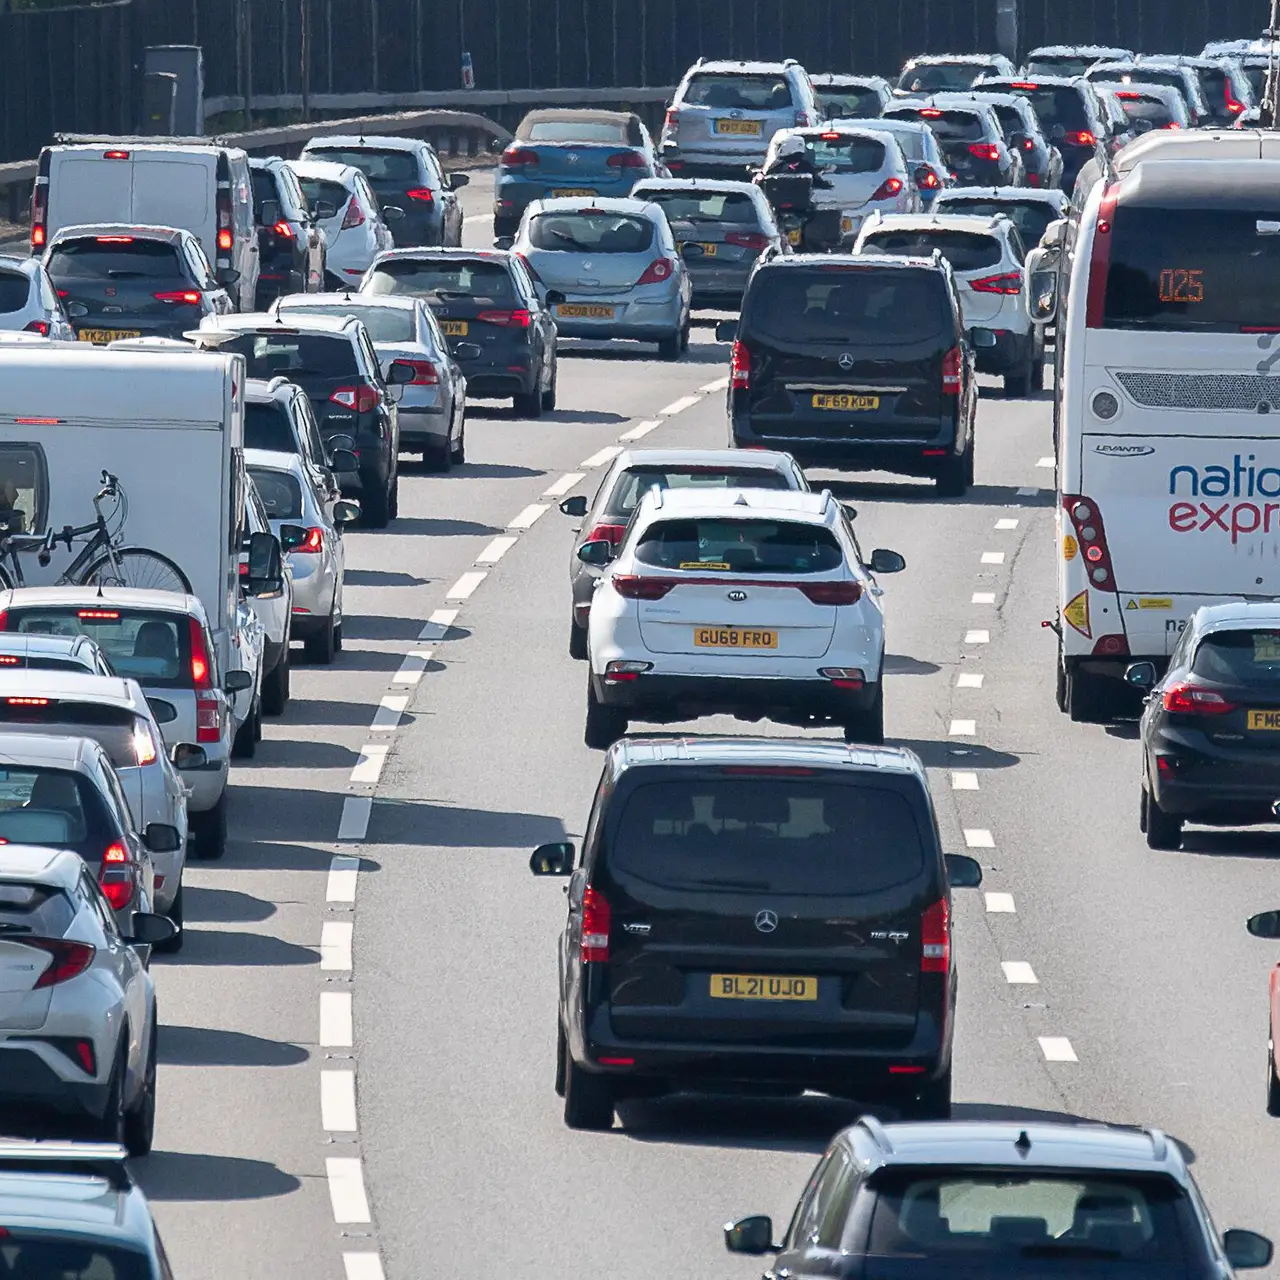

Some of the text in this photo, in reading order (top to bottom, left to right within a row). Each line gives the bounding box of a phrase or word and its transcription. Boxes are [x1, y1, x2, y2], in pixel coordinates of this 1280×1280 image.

[1159, 269, 1204, 302] 025
[729, 592, 745, 600] KIA
[699, 630, 772, 646] GU68 FRO
[722, 977, 807, 998] BL21 UJO
